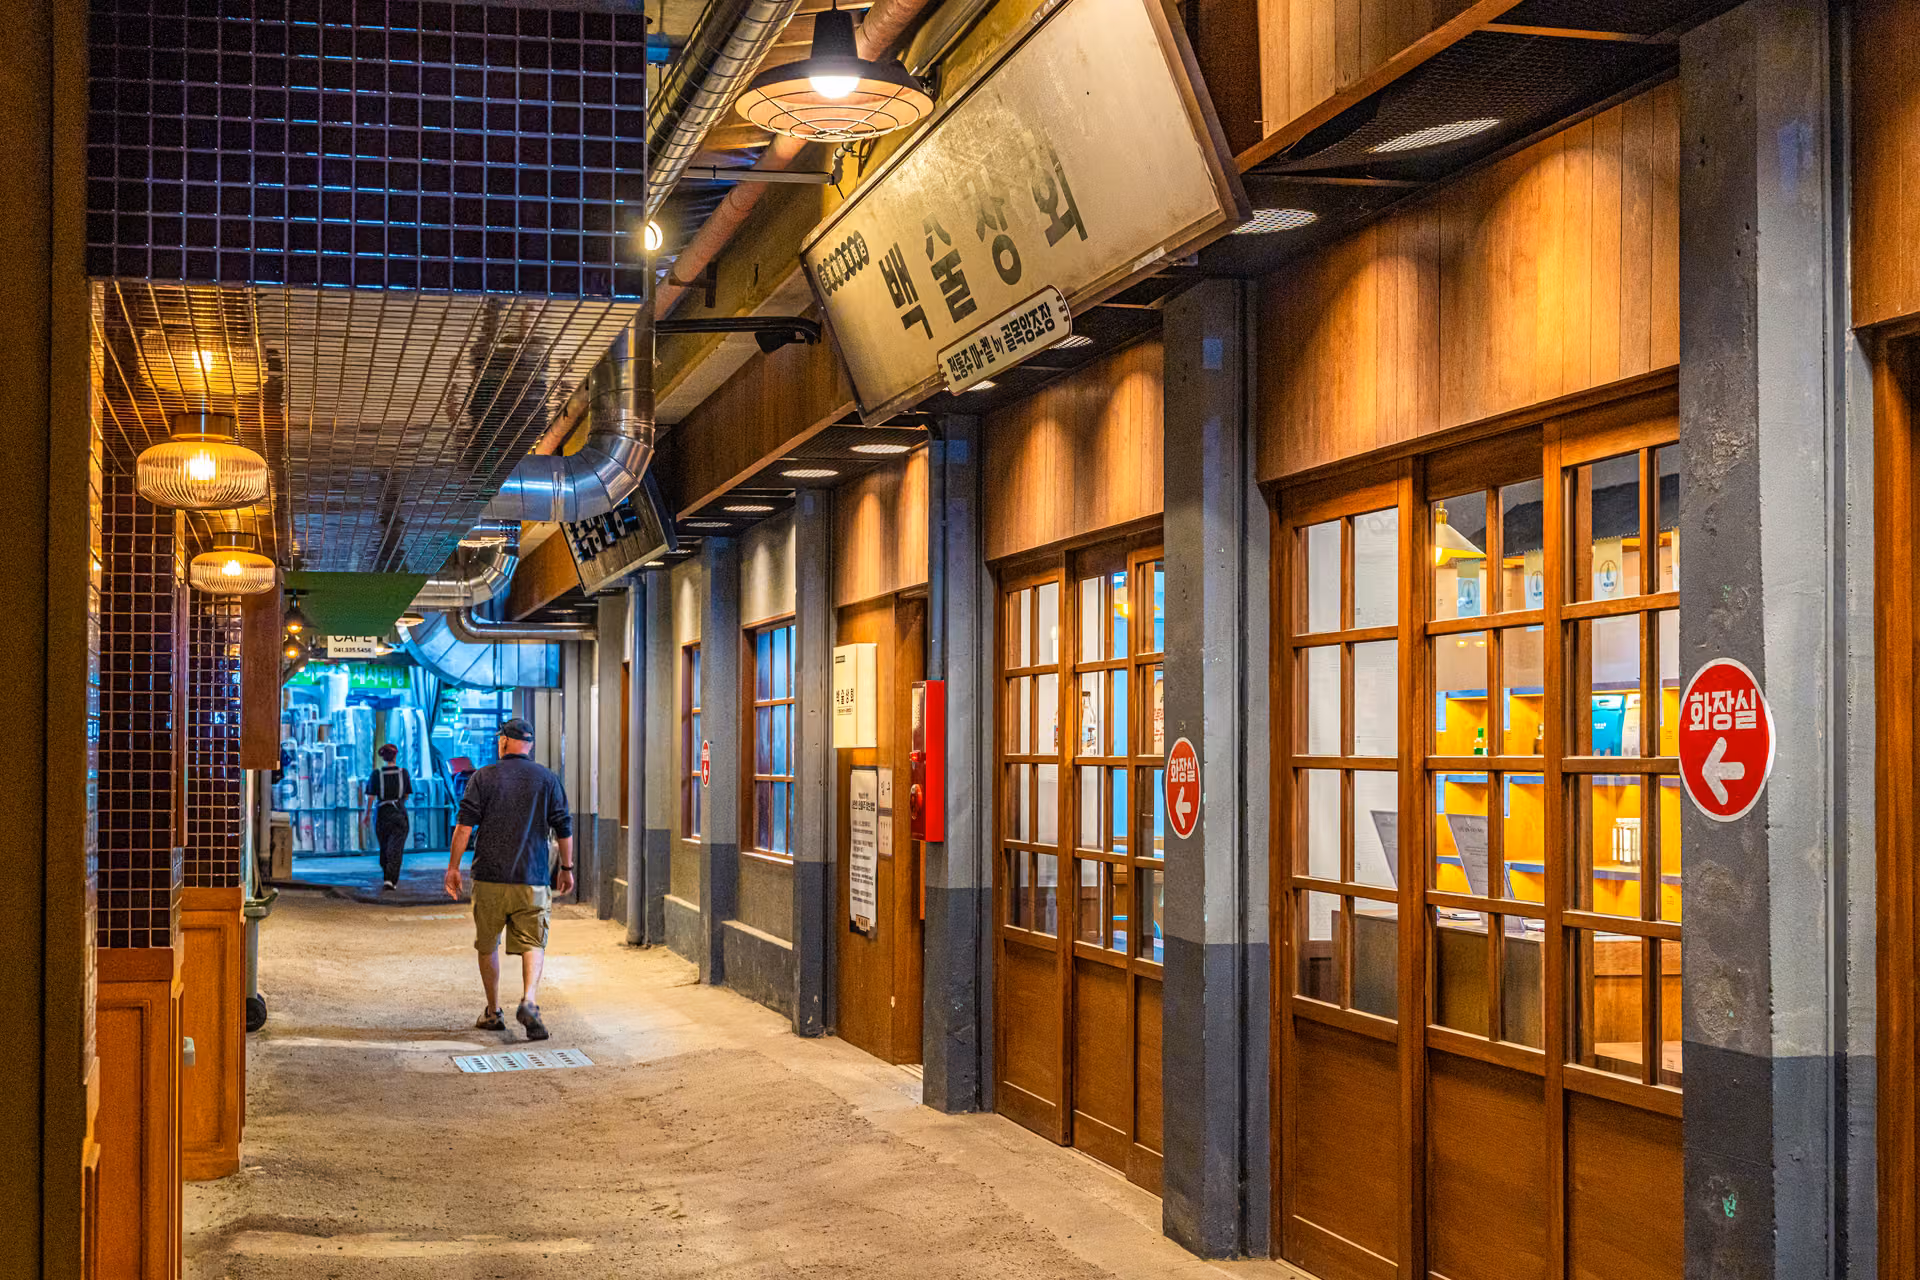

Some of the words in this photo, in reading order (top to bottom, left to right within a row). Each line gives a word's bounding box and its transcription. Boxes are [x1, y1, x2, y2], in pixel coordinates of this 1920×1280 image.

[990, 335, 1005, 355] by
[1000, 302, 1056, 353] 골목양조장
[1689, 688, 1757, 732] 화장실
[1170, 757, 1196, 783] 화장실
